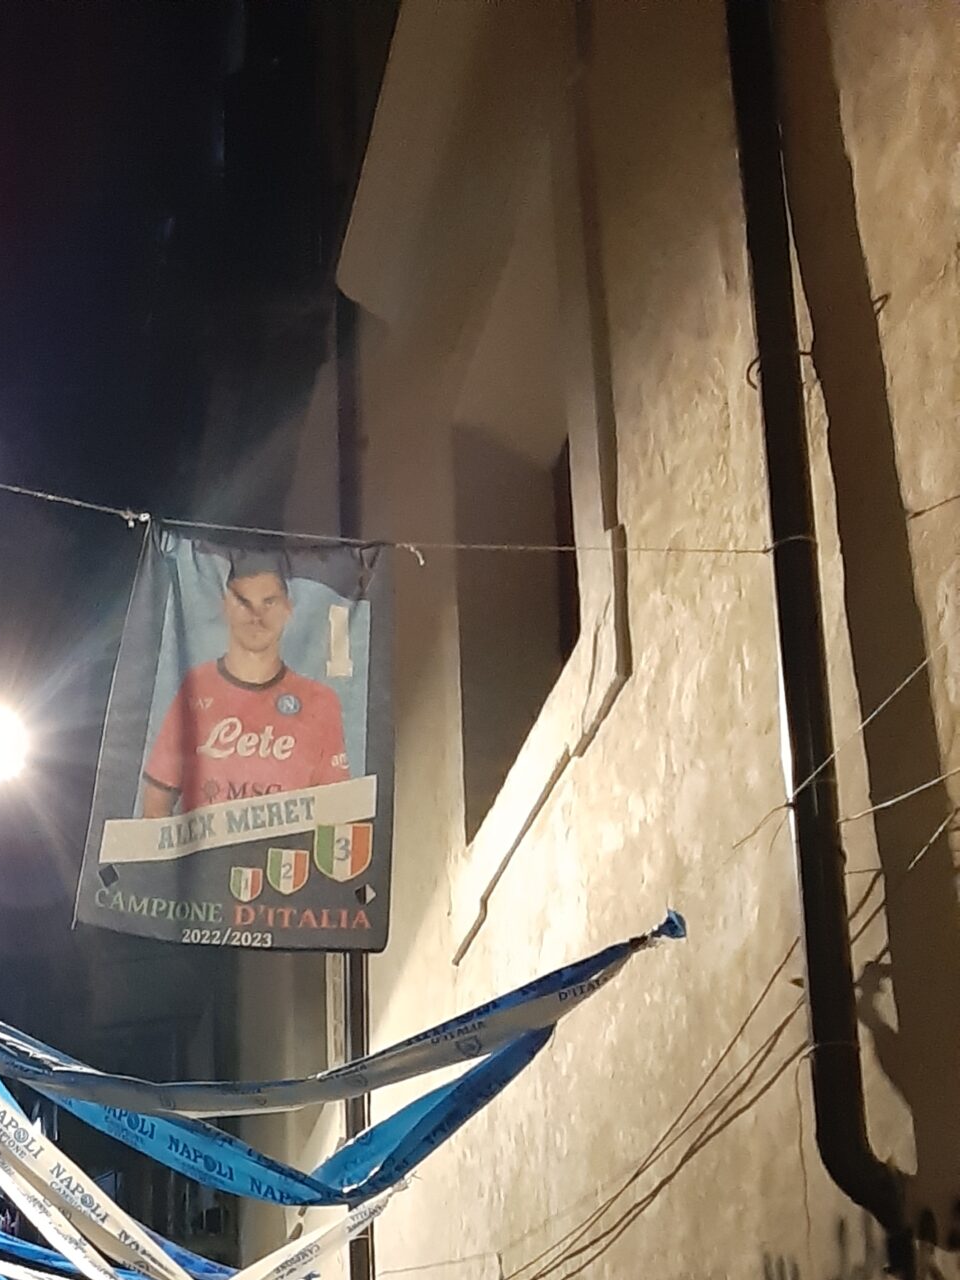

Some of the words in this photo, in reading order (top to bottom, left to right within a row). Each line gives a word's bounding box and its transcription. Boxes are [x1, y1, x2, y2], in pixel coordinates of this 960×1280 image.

[196, 717, 296, 760] Lete
[158, 813, 216, 850] ALEX
[226, 796, 316, 834] MERET
[334, 837, 350, 861] 3
[281, 863, 293, 879] 2
[95, 889, 224, 923] CAMPIONE
[233, 904, 372, 930] D'ITALIA
[181, 927, 273, 948] 2022/2023
[167, 1134, 235, 1182] NAPOLI
[49, 1161, 110, 1224] NAPOLI
